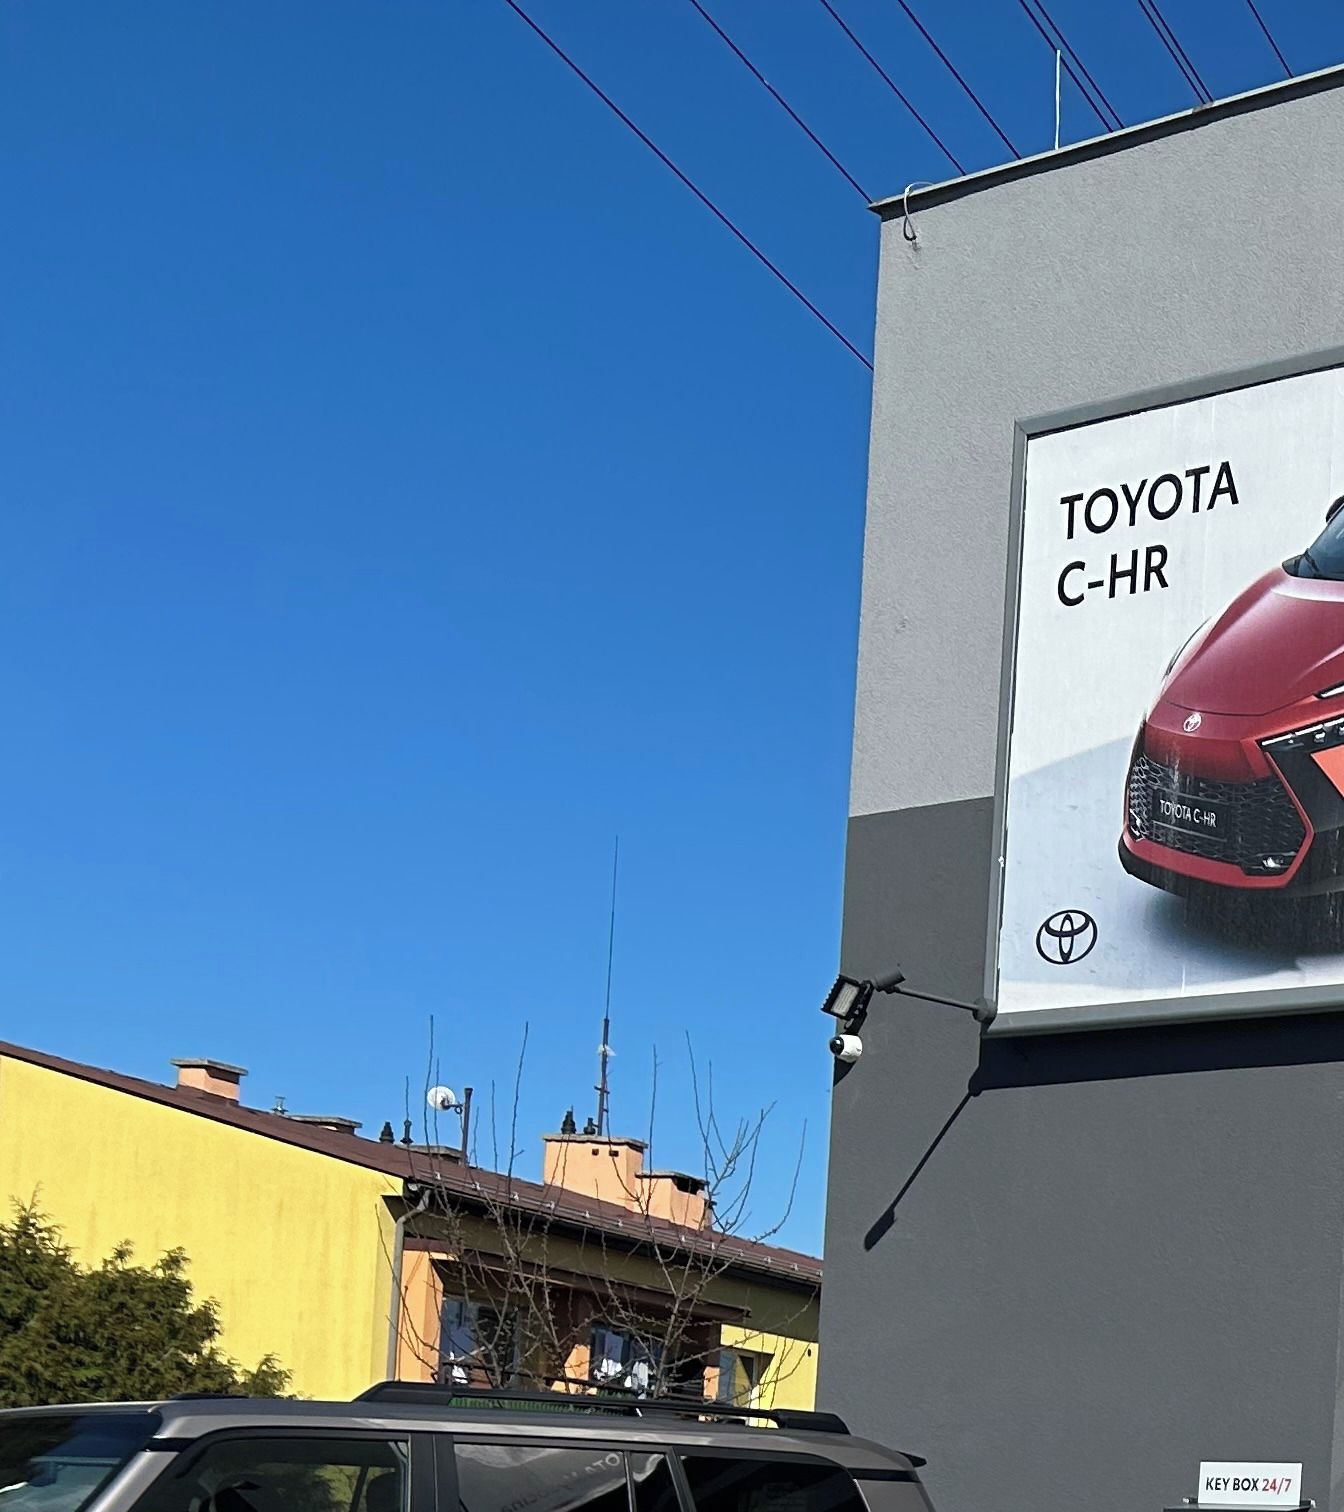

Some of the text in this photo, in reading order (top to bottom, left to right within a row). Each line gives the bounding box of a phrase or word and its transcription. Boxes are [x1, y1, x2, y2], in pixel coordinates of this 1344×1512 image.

[1059, 460, 1239, 540] TOYOTA
[1057, 544, 1169, 607] C-HR
[1159, 799, 1217, 828] TOYOTA C-HR
[1205, 1476, 1292, 1495] KEY BOX 24/7
